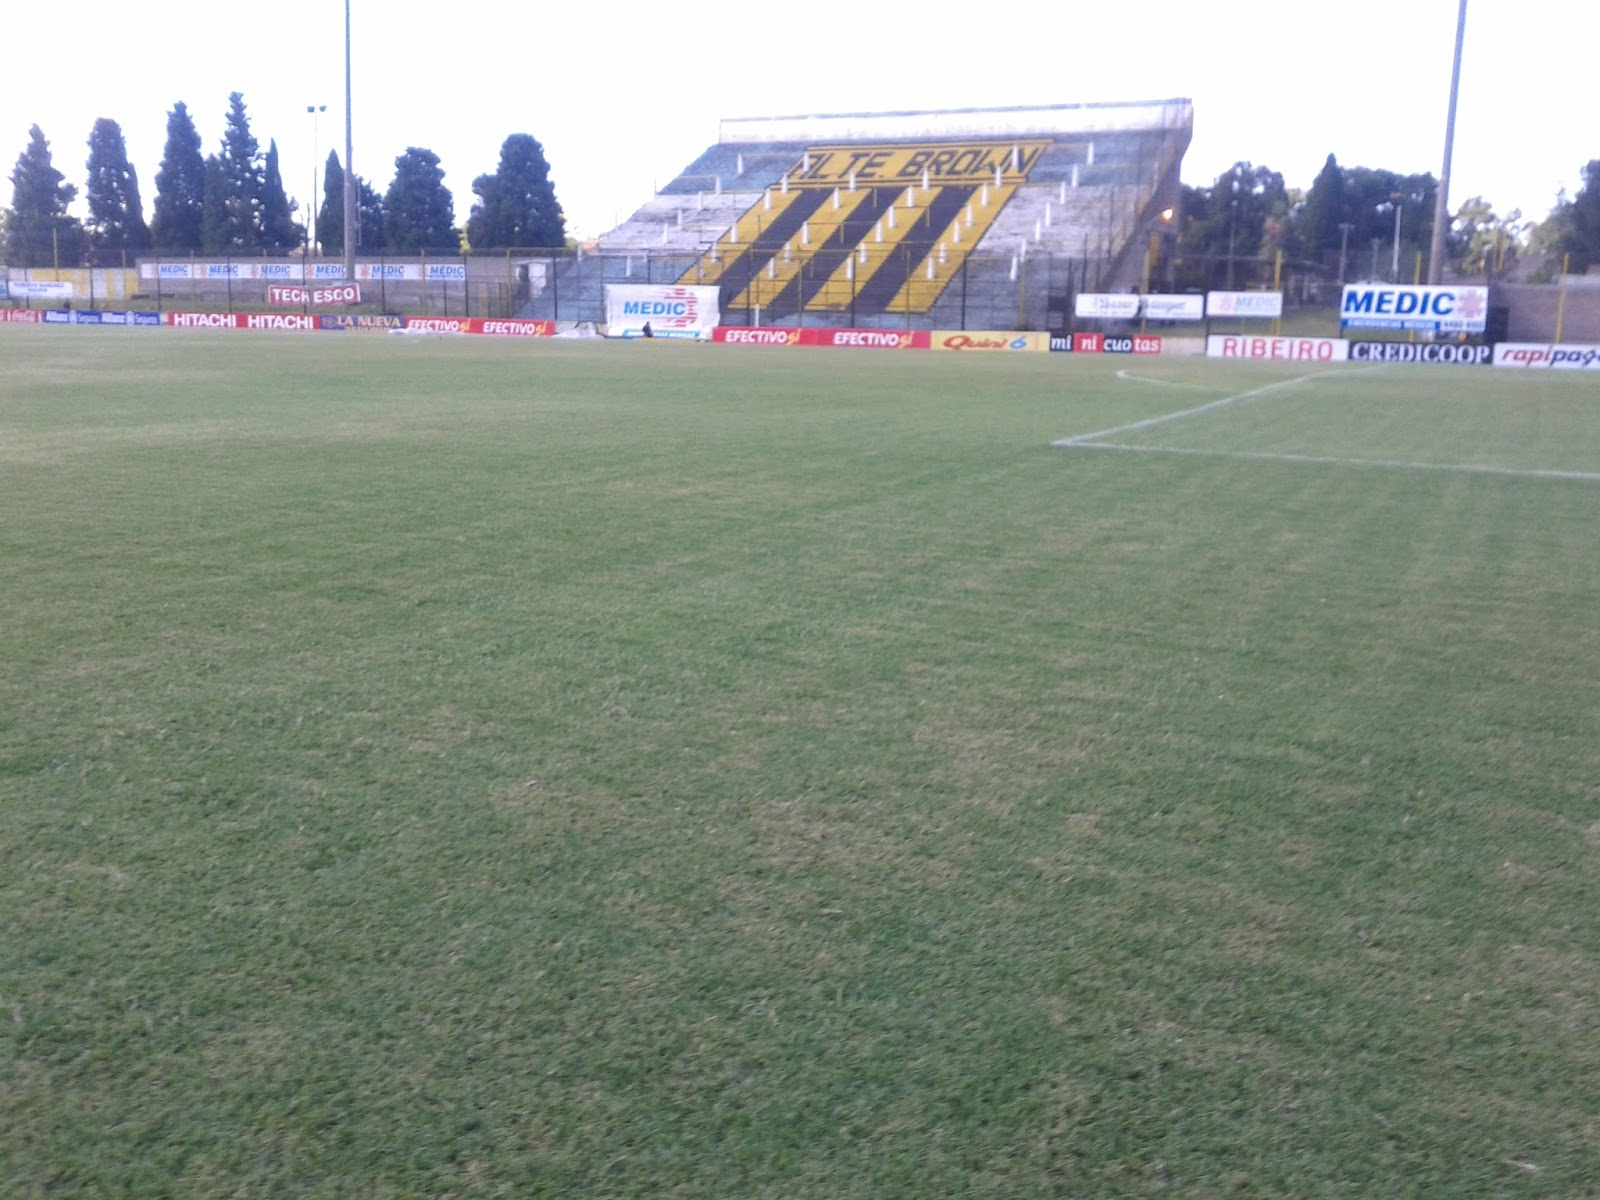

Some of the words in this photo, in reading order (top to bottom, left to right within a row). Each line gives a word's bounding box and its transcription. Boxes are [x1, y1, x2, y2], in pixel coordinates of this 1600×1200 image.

[897, 146, 1040, 177] BROWN
[160, 264, 188, 274] MEDIC
[208, 264, 239, 274] MEDIC
[260, 264, 291, 274] MEDIC
[371, 264, 405, 275] MEDIC
[429, 265, 465, 276] MEDIC
[623, 301, 687, 316] MEDIC
[1344, 290, 1456, 315] MEDIC
[174, 313, 237, 328] HITACHI
[247, 314, 314, 329] HITACHI
[337, 315, 354, 326] LA
[358, 316, 401, 328] NUEVA
[408, 319, 459, 332] EFECTIVO
[483, 321, 535, 335] EFECTIVO
[725, 329, 787, 344] EFECTIVO
[833, 331, 899, 347] EFECTIVO
[1222, 337, 1334, 360] RIBEIRO
[1351, 342, 1491, 364] CREDICOOP
